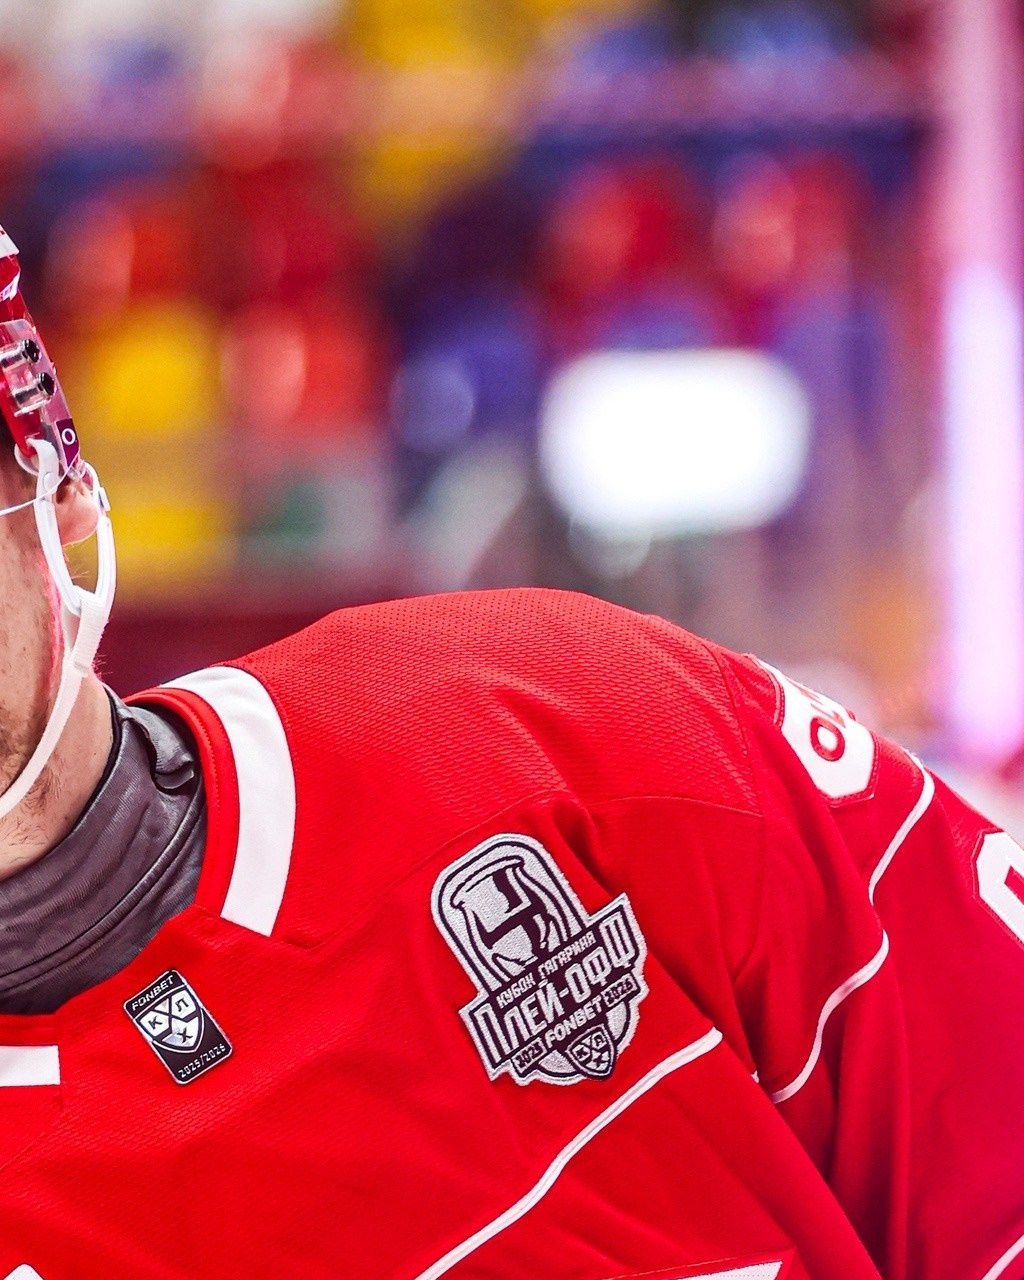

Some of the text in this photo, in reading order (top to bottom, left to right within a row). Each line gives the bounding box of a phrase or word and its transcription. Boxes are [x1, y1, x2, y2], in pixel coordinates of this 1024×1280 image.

[131, 974, 175, 1012] FONBET
[473, 911, 636, 1064] ПЛЕЙ-ОФФ
[496, 930, 596, 1009] КУБОК ГАГАРИНА
[544, 995, 603, 1049] FONBET
[178, 1043, 226, 1079] 2025/2026
